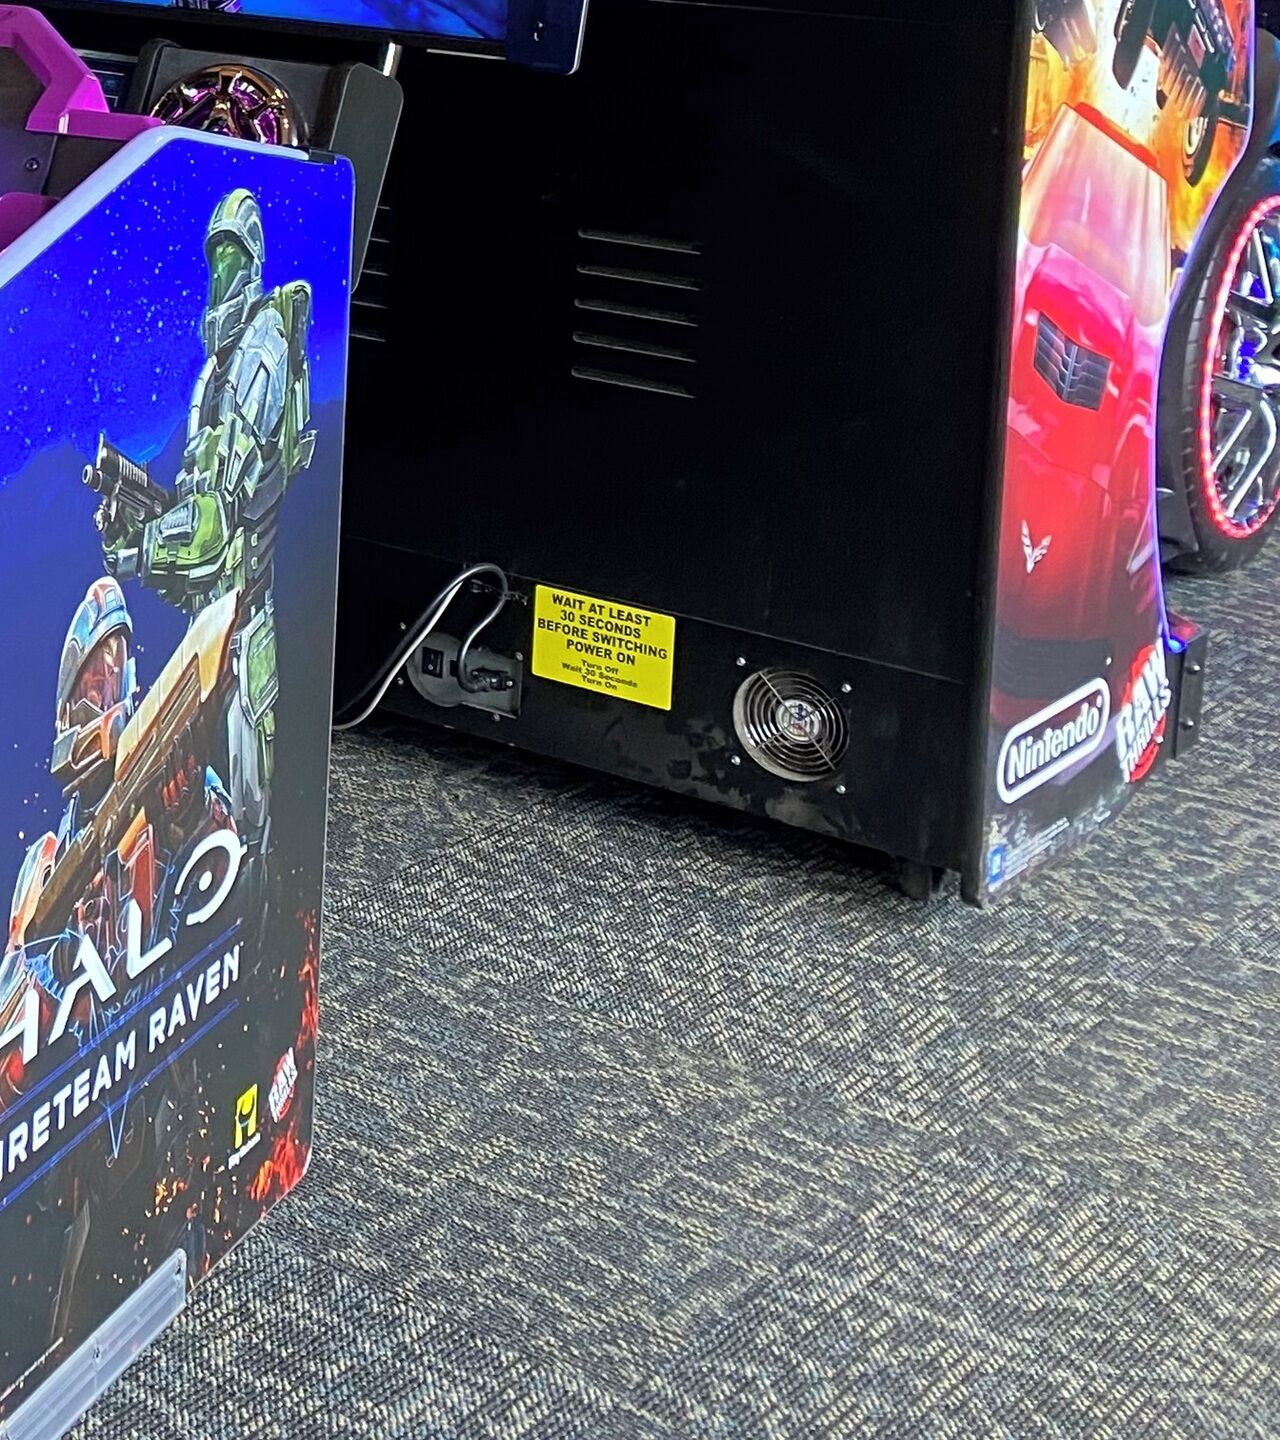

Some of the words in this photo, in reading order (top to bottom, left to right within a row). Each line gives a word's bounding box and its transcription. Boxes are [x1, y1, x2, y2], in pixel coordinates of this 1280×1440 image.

[552, 593, 585, 611] WAIT
[588, 603, 605, 615] AT
[608, 607, 651, 627] LEAST
[560, 609, 575, 622] 30
[579, 614, 641, 639] SECONDS
[537, 617, 589, 640] BEFORE
[592, 631, 668, 660] SWITCHING
[566, 639, 613, 661] POWER
[616, 652, 636, 666] ON
[561, 662, 582, 674] Wait
[584, 667, 596, 677] 30
[598, 671, 638, 688] Seconds
[581, 658, 602, 671] Turn
[604, 665, 619, 675] Off
[581, 675, 602, 687] Turn
[604, 681, 618, 691] On
[1006, 700, 1100, 785] Nintendo
[147, 949, 241, 1053] RAVEN
